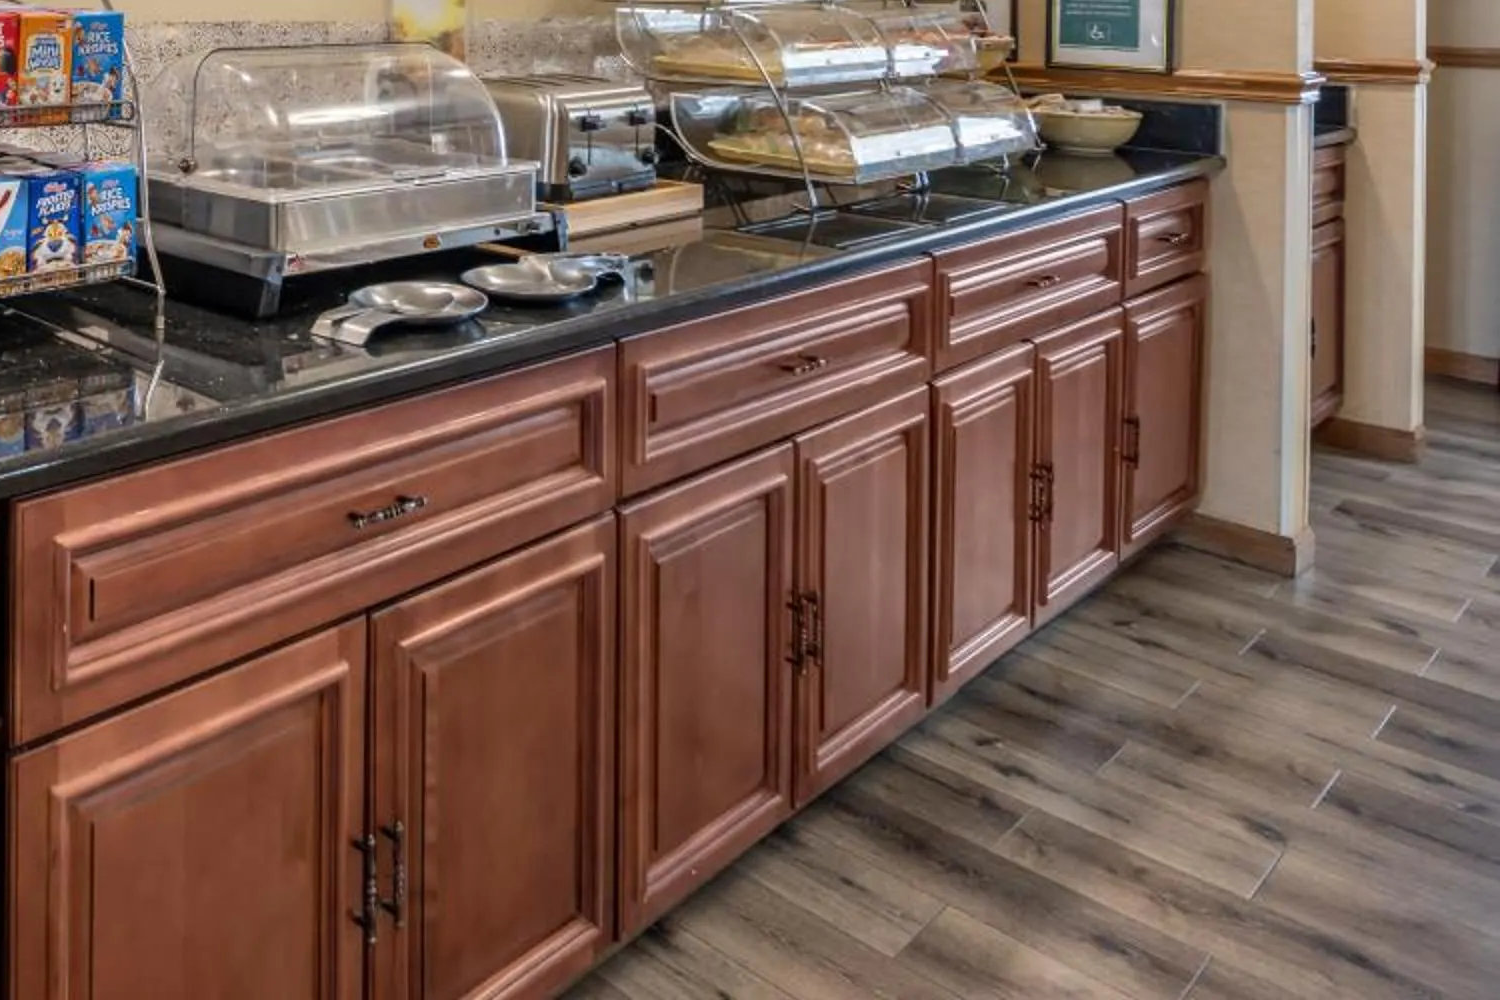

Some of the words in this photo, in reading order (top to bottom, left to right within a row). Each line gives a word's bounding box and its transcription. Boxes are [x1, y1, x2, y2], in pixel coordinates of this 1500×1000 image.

[86, 31, 111, 43] RICE
[29, 42, 61, 58] Mini
[101, 187, 123, 200] RICE
